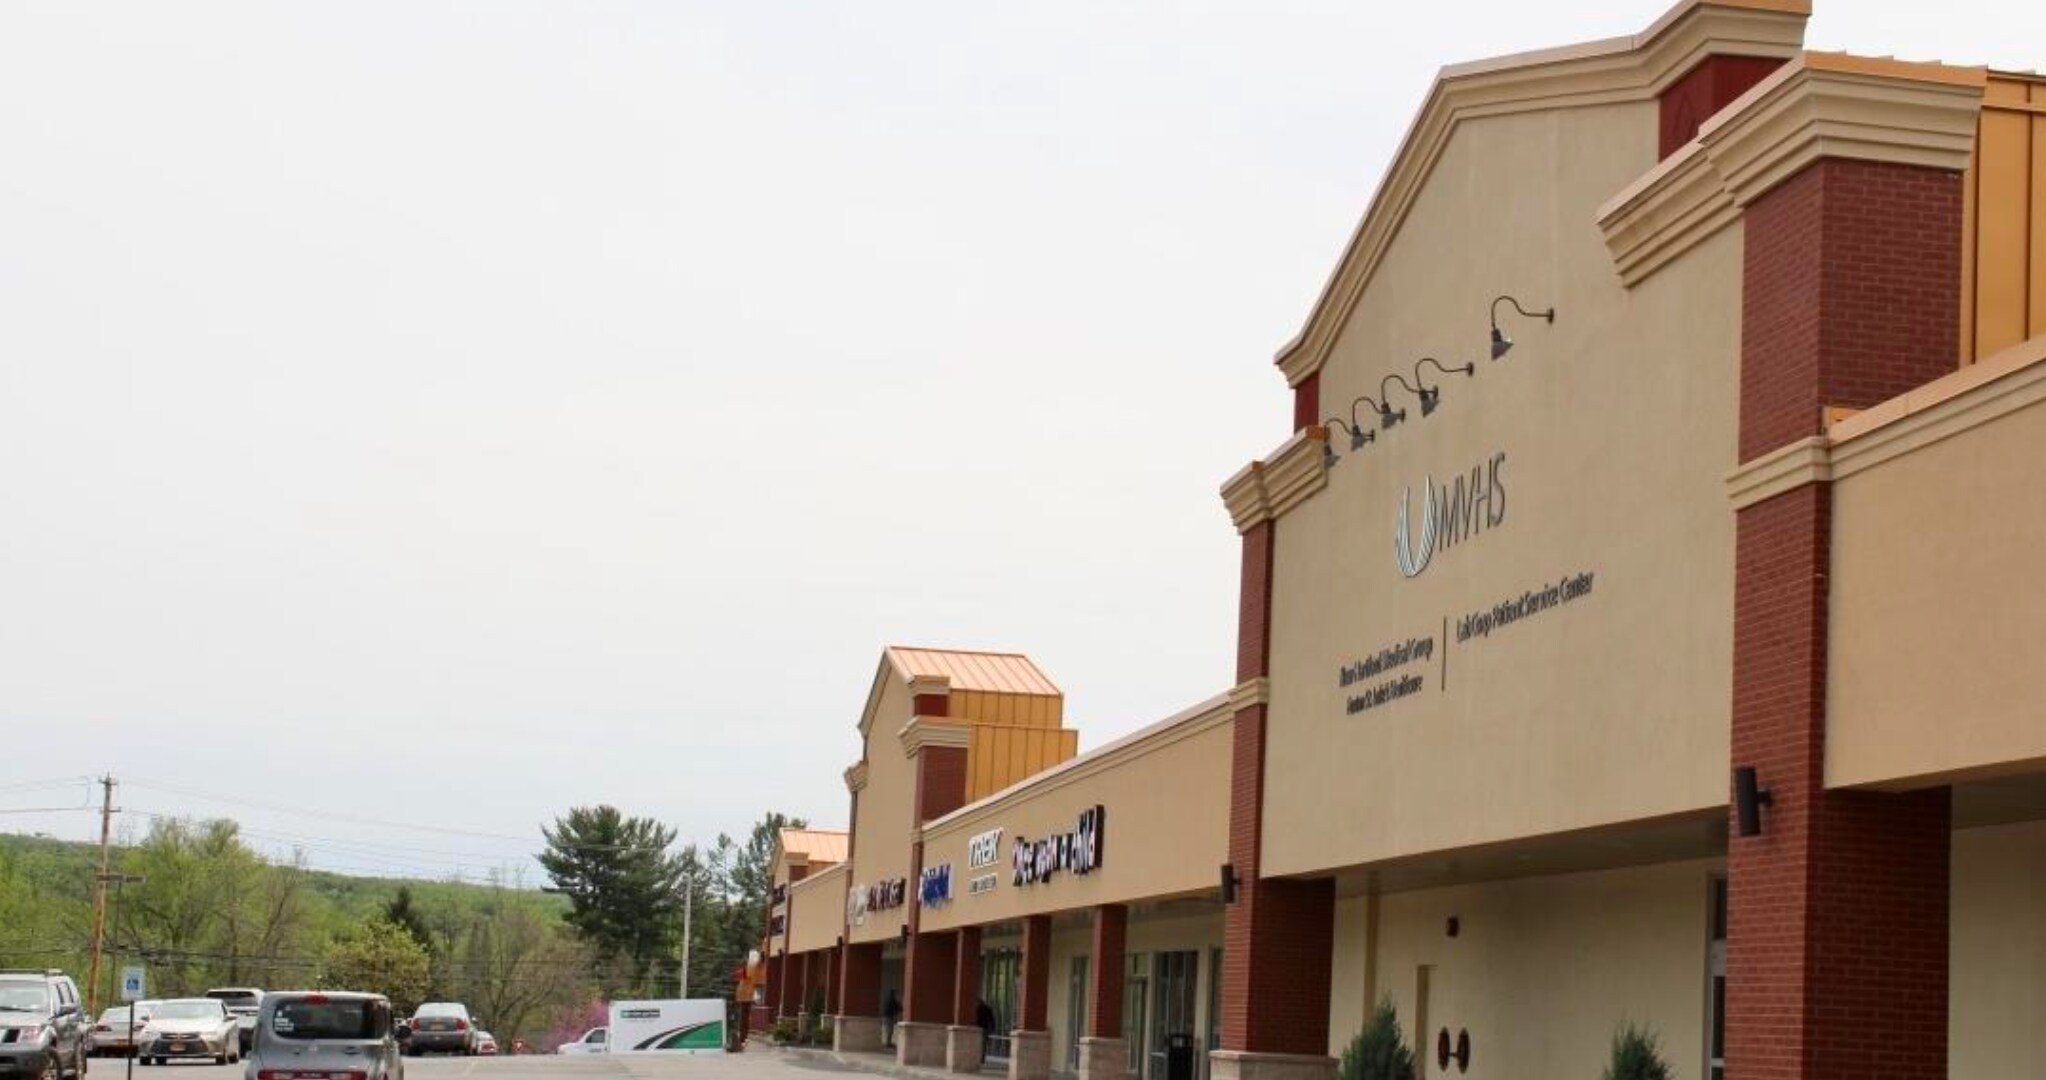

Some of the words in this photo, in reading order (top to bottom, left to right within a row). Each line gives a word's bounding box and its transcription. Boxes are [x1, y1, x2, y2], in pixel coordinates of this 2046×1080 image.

[1438, 451, 1505, 552] MVHS
[1559, 571, 1594, 602] Center
[968, 826, 1004, 870] TREK
